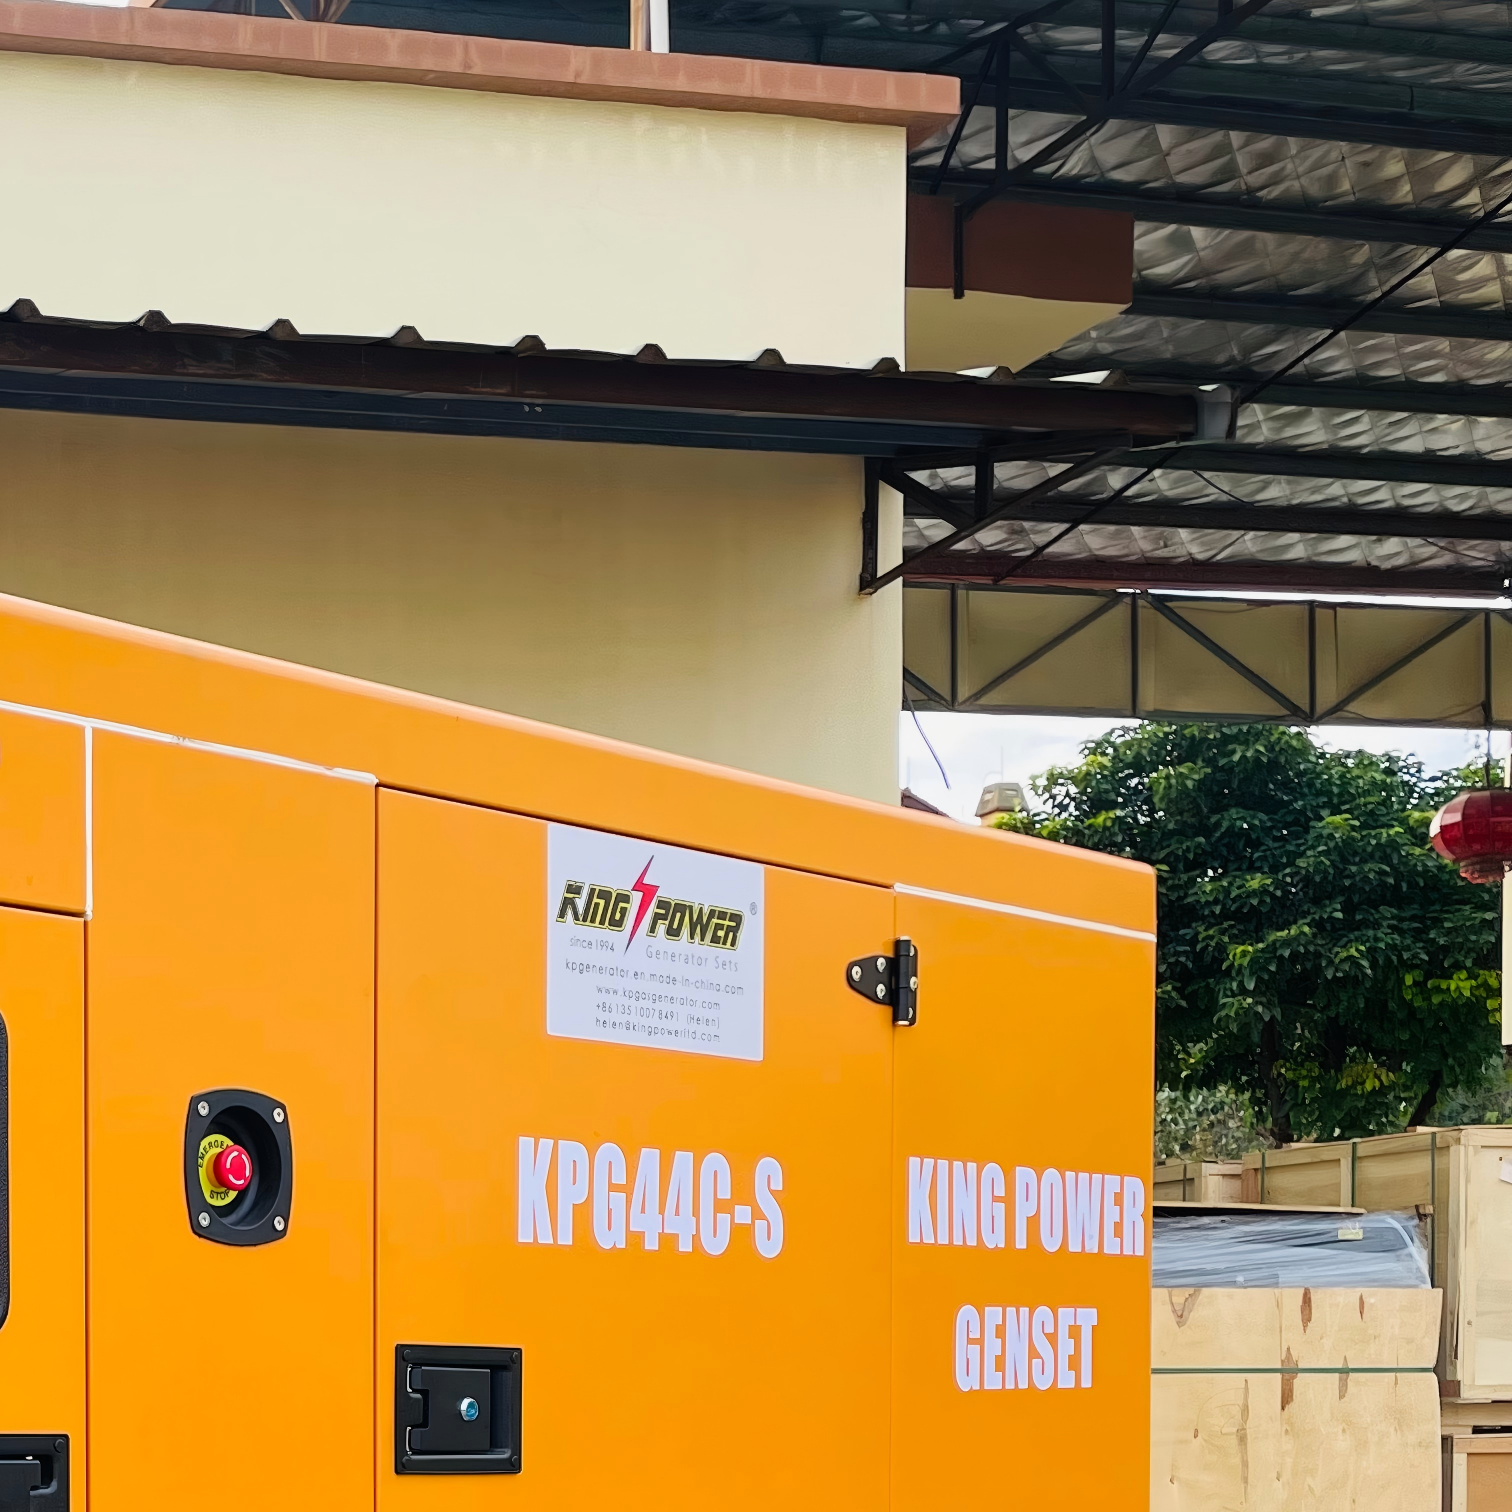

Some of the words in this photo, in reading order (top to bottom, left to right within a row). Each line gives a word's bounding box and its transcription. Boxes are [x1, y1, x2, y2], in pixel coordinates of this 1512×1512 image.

[555, 880, 633, 932] KING
[646, 895, 745, 951] POWER
[570, 935, 593, 950] since
[595, 939, 615, 952] 1994
[645, 945, 708, 967] Generator
[714, 956, 738, 972] Sets
[518, 1136, 784, 1258] KPG44C-S
[908, 1156, 1006, 1249] KING
[1015, 1166, 1145, 1256] POWER
[955, 1304, 1098, 1392] GENSET
